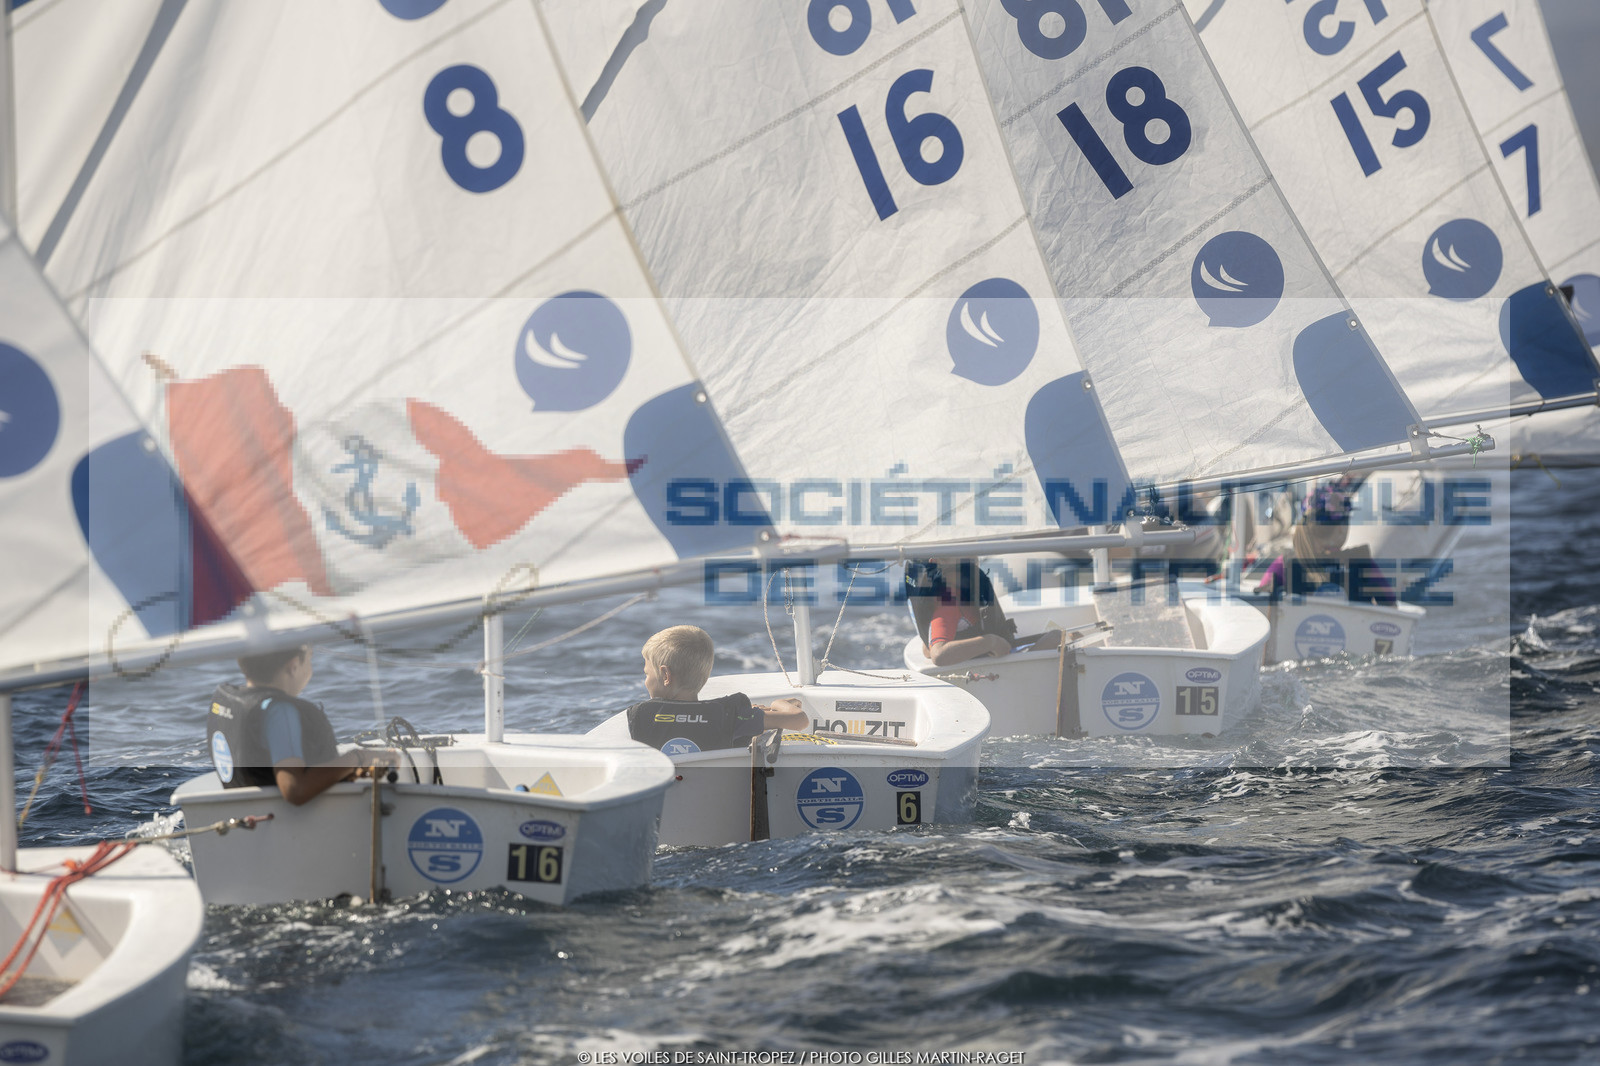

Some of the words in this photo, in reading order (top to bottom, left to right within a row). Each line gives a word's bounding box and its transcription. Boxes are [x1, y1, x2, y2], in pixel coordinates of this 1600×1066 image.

[1330, 50, 1431, 178] 15
[423, 64, 525, 193] 8
[1056, 66, 1192, 200] 18
[837, 68, 964, 221] 16
[1499, 123, 1541, 218] 7
[1114, 681, 1145, 695] N
[1179, 687, 1216, 715] 15
[675, 714, 708, 723] GUL
[1118, 708, 1144, 722] S
[670, 744, 692, 754] N
[811, 777, 847, 793] N
[816, 807, 845, 824] S
[900, 792, 917, 823] 6
[424, 819, 466, 838] N
[428, 854, 461, 872] S
[511, 845, 559, 882] 16
